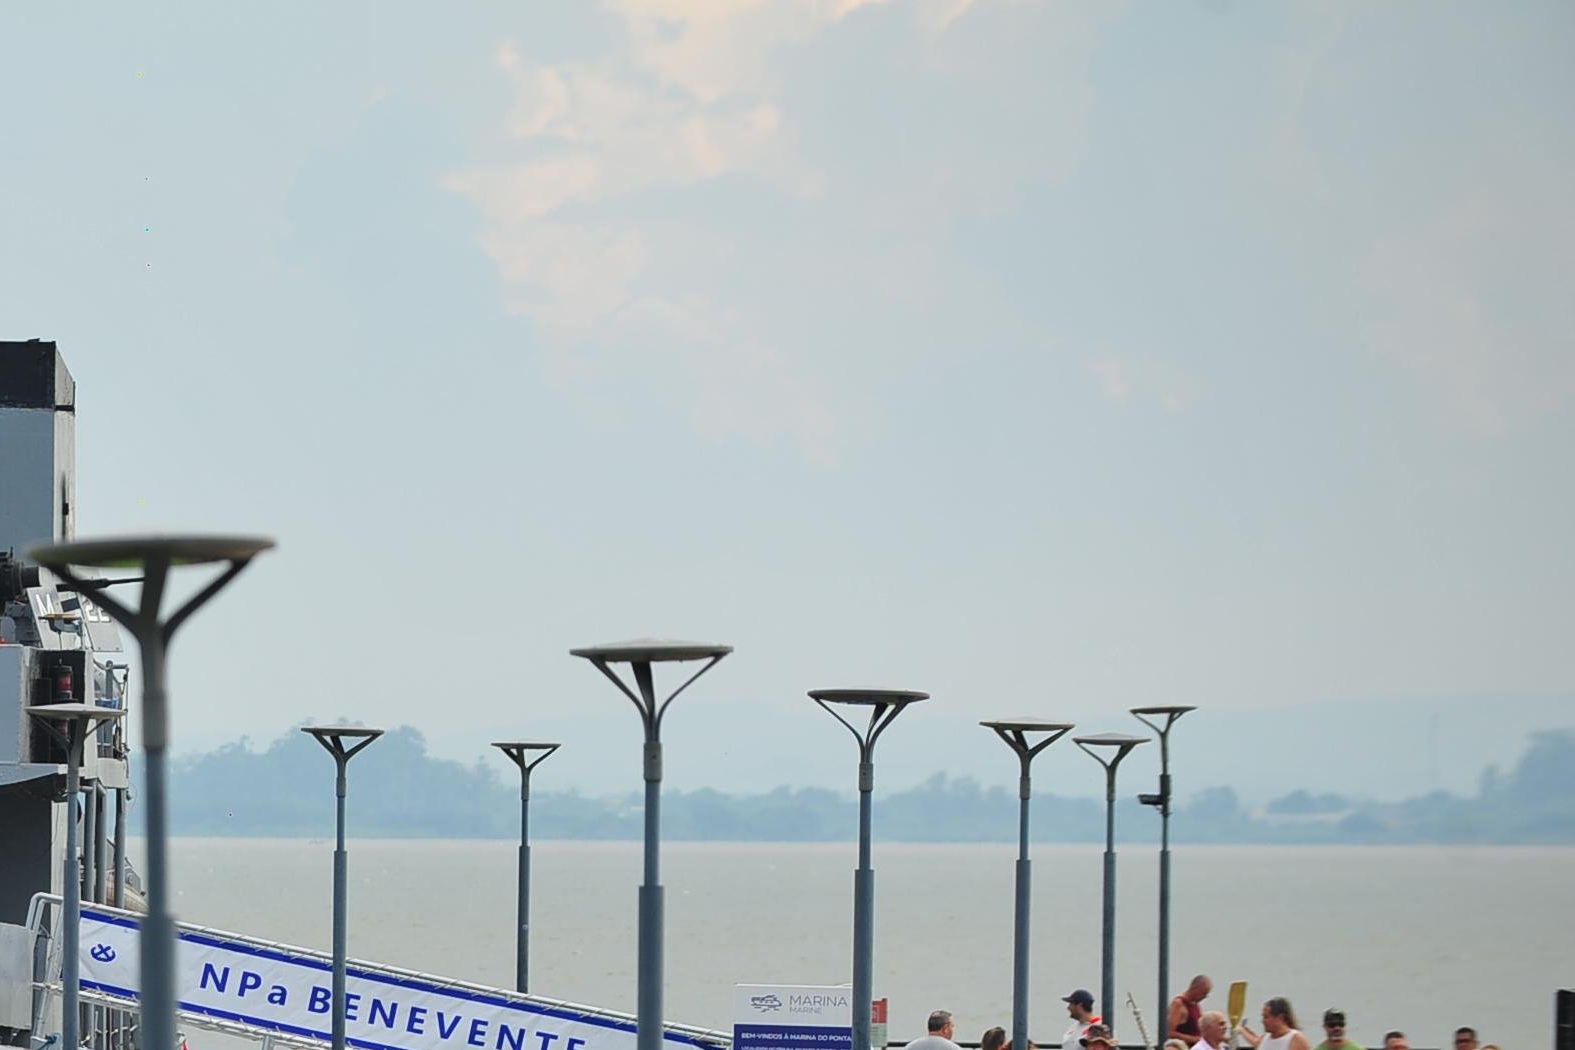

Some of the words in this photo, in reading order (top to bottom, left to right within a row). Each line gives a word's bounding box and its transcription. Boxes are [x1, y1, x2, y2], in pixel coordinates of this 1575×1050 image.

[198, 962, 289, 1006] NPa
[789, 995, 848, 1007] MARINA
[741, 1032, 783, 1040] BEM-VINDOS
[790, 1033, 817, 1041] MARINA
